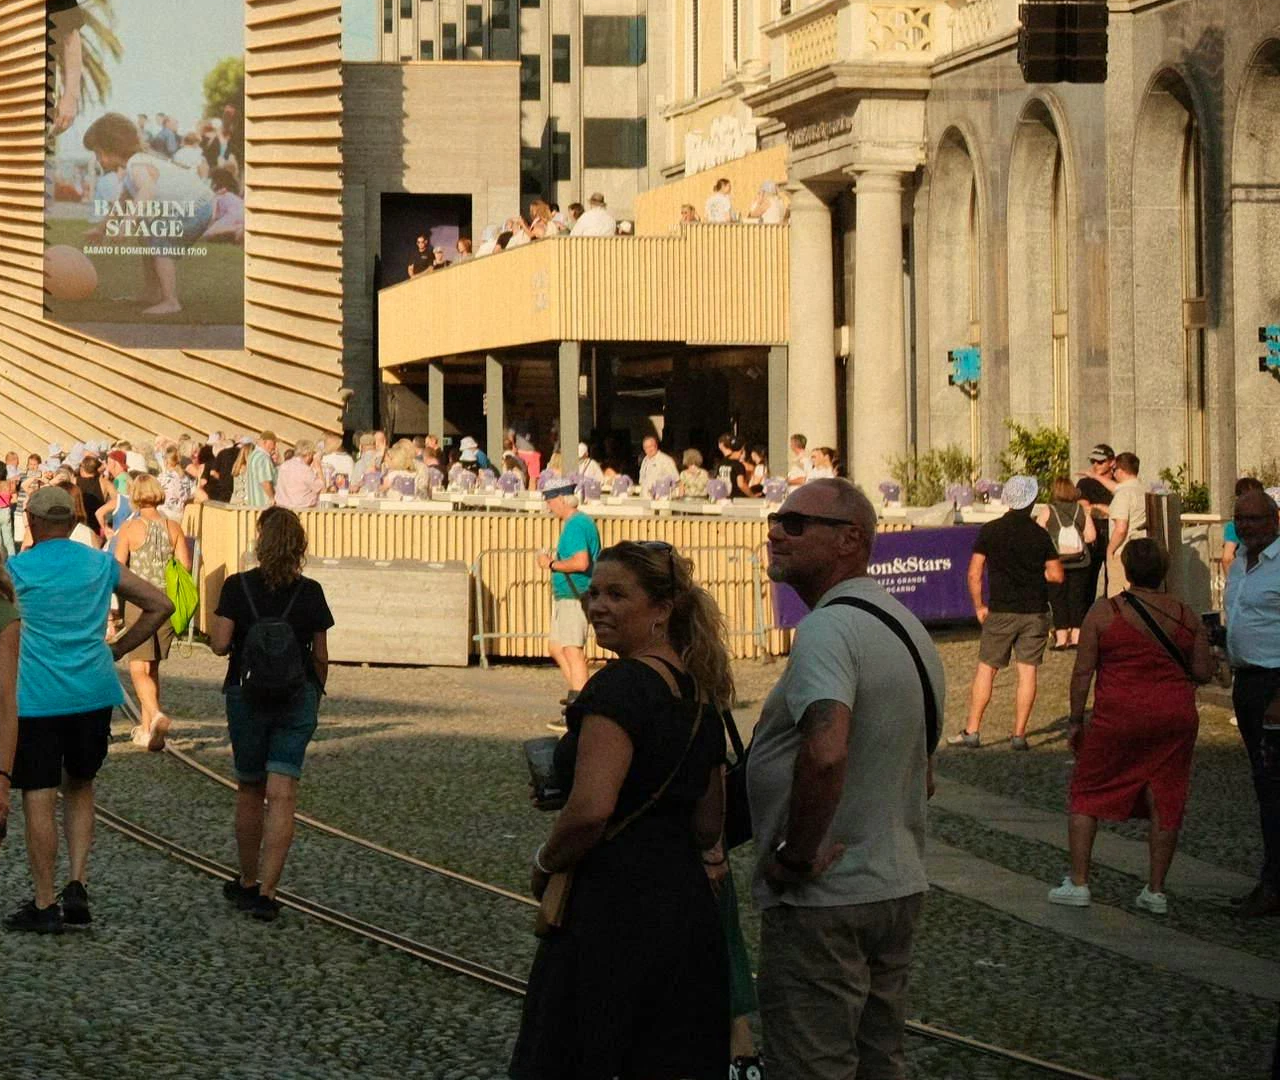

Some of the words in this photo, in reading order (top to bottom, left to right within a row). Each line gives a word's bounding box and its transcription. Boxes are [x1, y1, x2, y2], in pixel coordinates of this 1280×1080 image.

[94, 199, 196, 217] BAMBINI
[105, 219, 184, 237] STAGE
[83, 245, 113, 255] SABATO
[114, 246, 119, 254] E
[120, 246, 161, 255] DOMENICA
[162, 247, 185, 255] DALLE
[187, 247, 208, 256] 17:00
